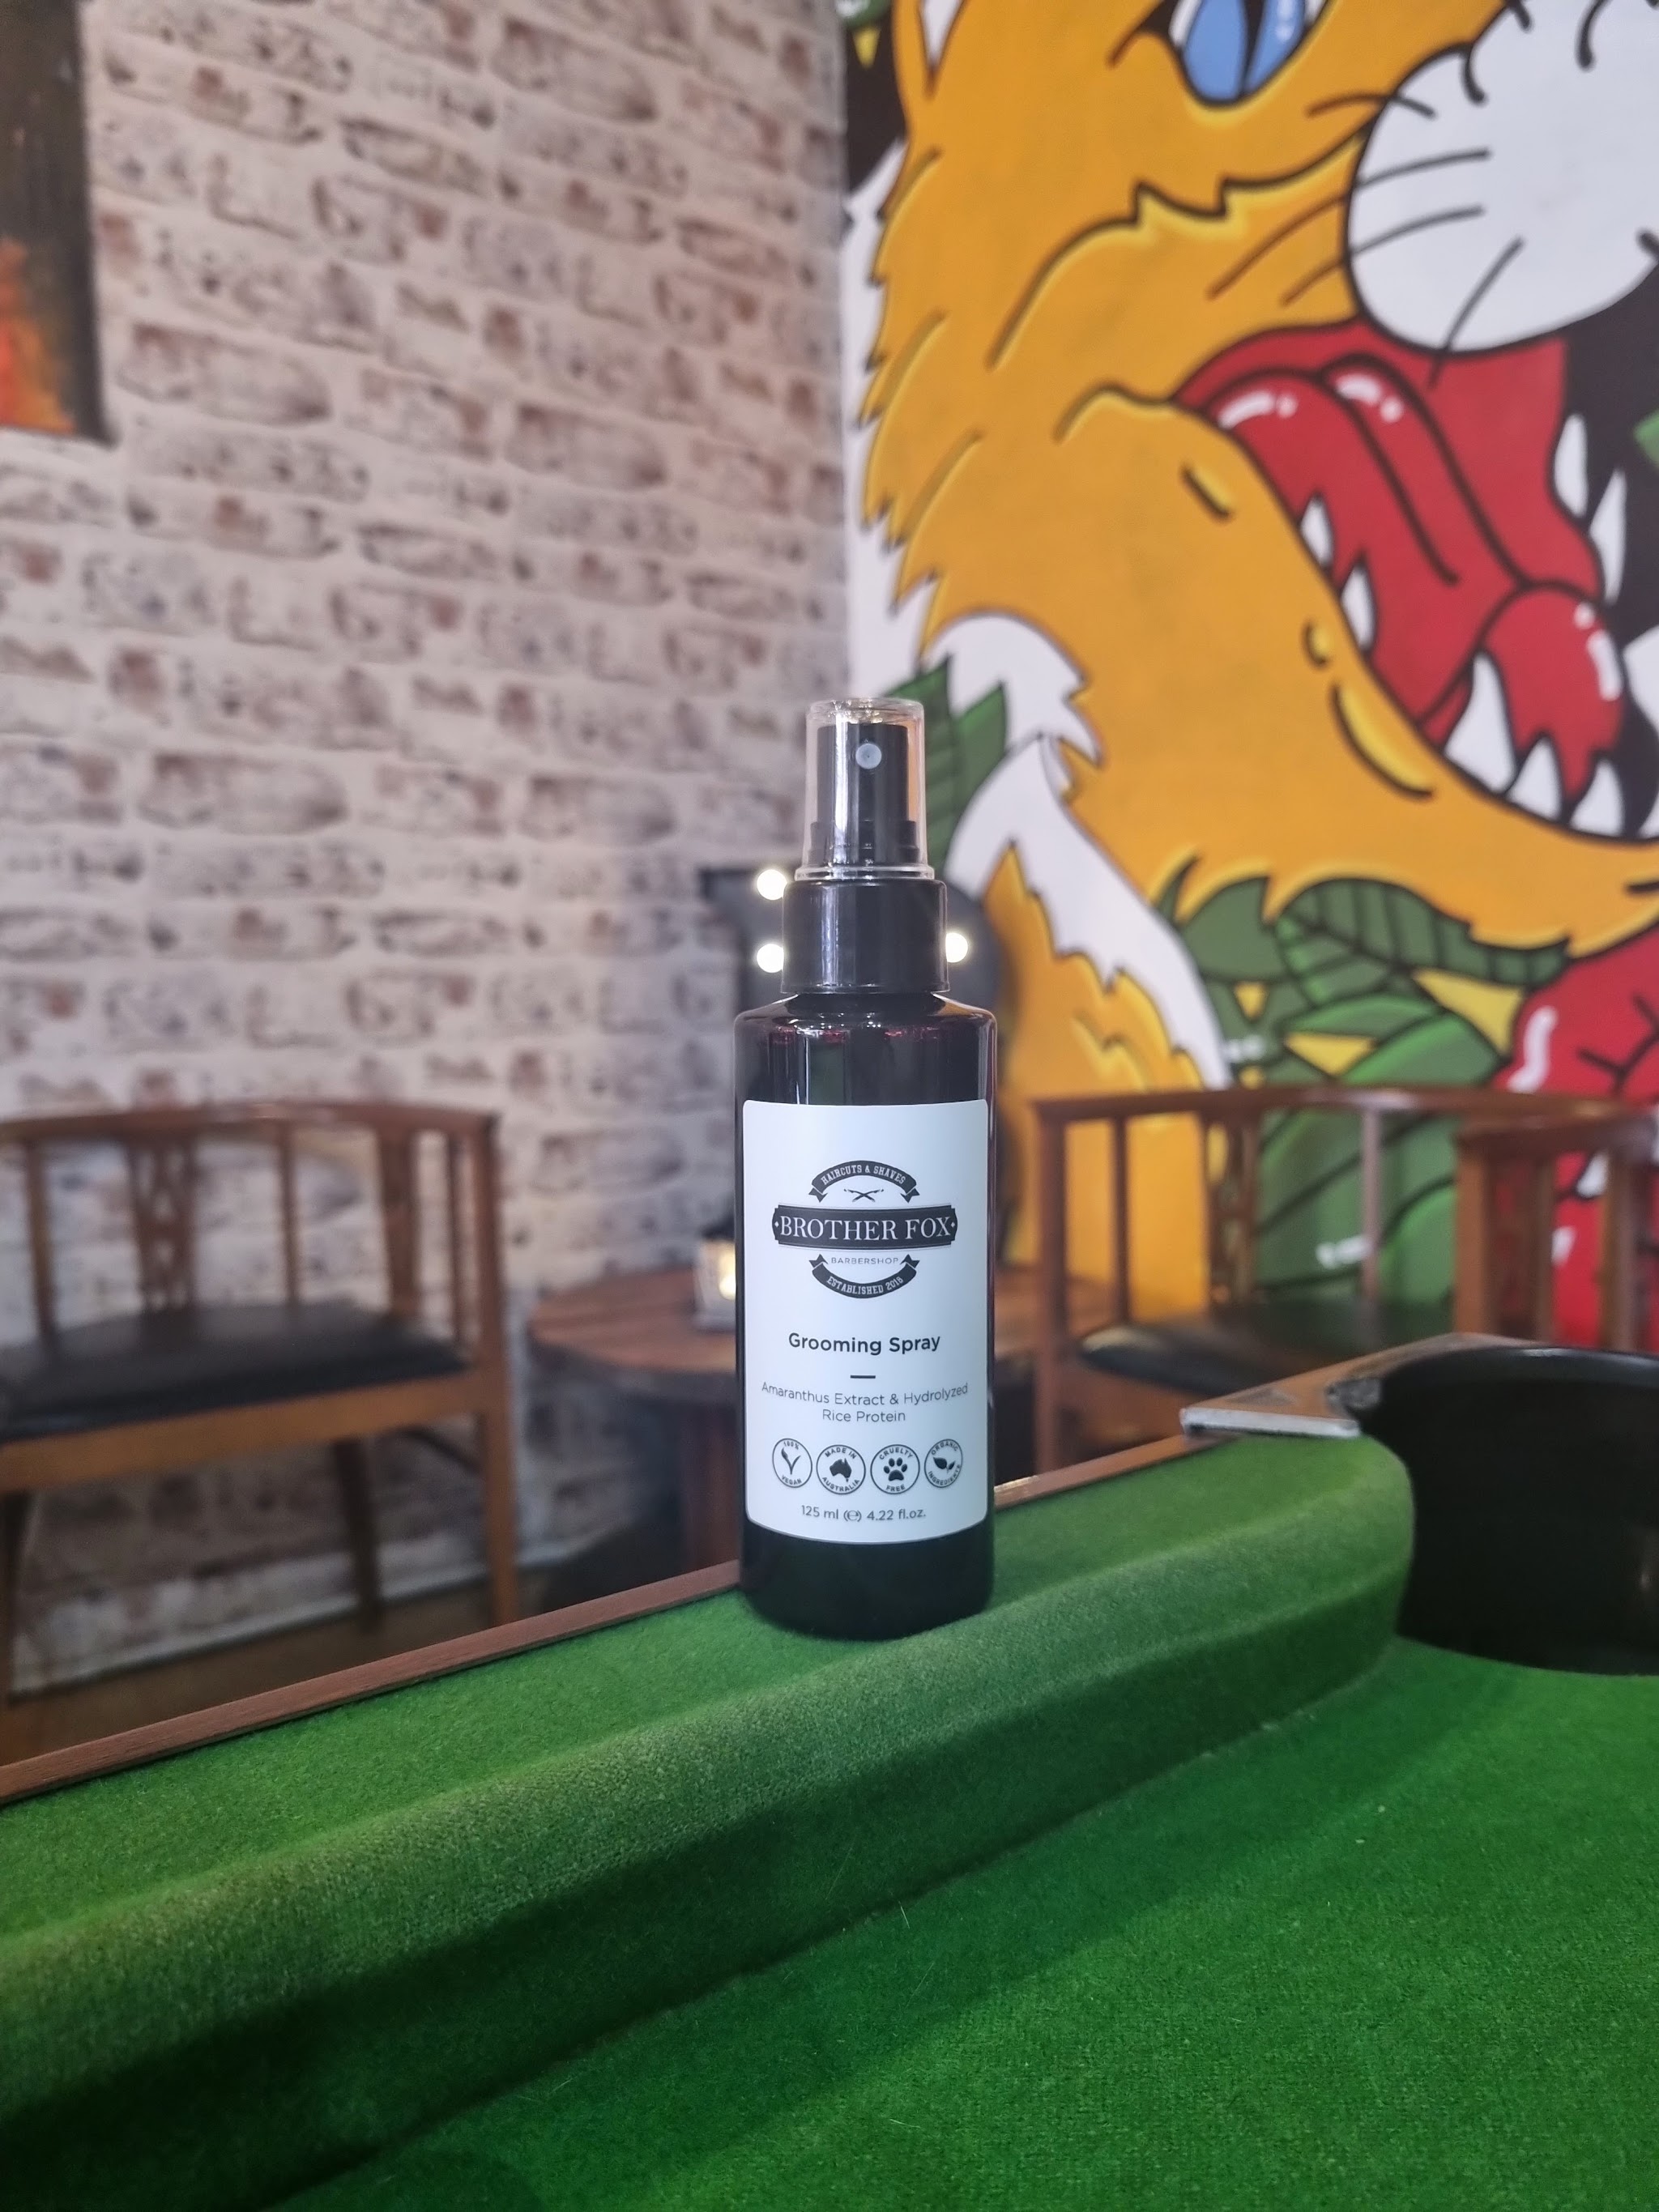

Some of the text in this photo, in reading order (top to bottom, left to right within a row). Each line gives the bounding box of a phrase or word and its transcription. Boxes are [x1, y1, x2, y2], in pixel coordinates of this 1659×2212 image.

[821, 1164, 906, 1185] HAIRCUTS & SHAVES
[780, 1215, 951, 1241] BROTHER FOX
[831, 1257, 899, 1265] BARBERSHOP
[826, 1276, 884, 1295] ESTABLISHED
[788, 1332, 940, 1356] Grooming Spray
[761, 1381, 969, 1406] Amaranthus Extract & Hydrolyzed
[822, 1409, 906, 1422] Rice Protein
[783, 1441, 800, 1450] 100%
[931, 1441, 958, 1455] ORGANIC
[825, 1447, 857, 1460] MADE IN
[879, 1447, 913, 1460] CRUELTY
[782, 1475, 802, 1485] VEGAN
[822, 1477, 860, 1492] AUSTRALIA
[885, 1483, 906, 1492] FREE
[801, 1505, 820, 1517] 125
[824, 1508, 839, 1519] ml
[866, 1509, 894, 1521] 4.22
[898, 1508, 927, 1519] fl.oz.
